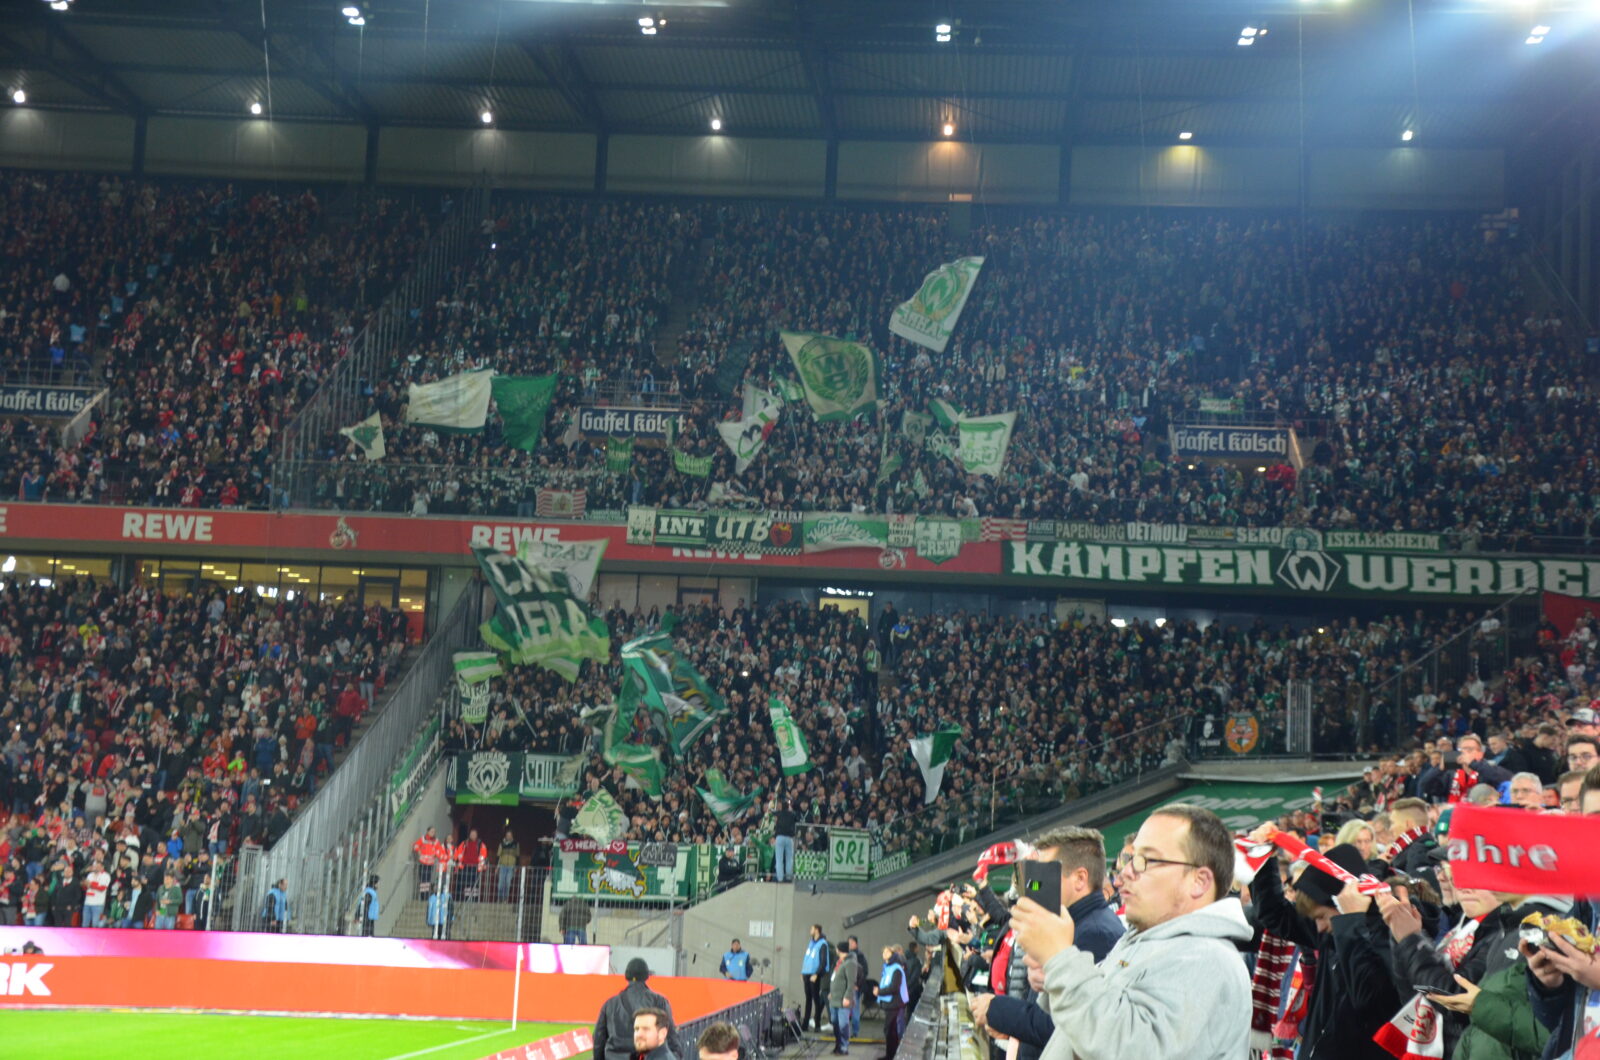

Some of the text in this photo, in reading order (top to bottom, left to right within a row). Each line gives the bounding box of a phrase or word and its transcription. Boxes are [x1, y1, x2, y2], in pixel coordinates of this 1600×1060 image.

[1175, 431, 1287, 455] Gaffel Kölsch
[122, 512, 213, 541] REWE
[659, 516, 705, 537] INT
[1056, 522, 1126, 540] PAPENBURG
[1127, 522, 1188, 542] DETMOLD
[1327, 532, 1440, 550] ISELERSHEIM
[1012, 541, 1274, 585] KÄMPFEN
[835, 840, 864, 865] SRL
